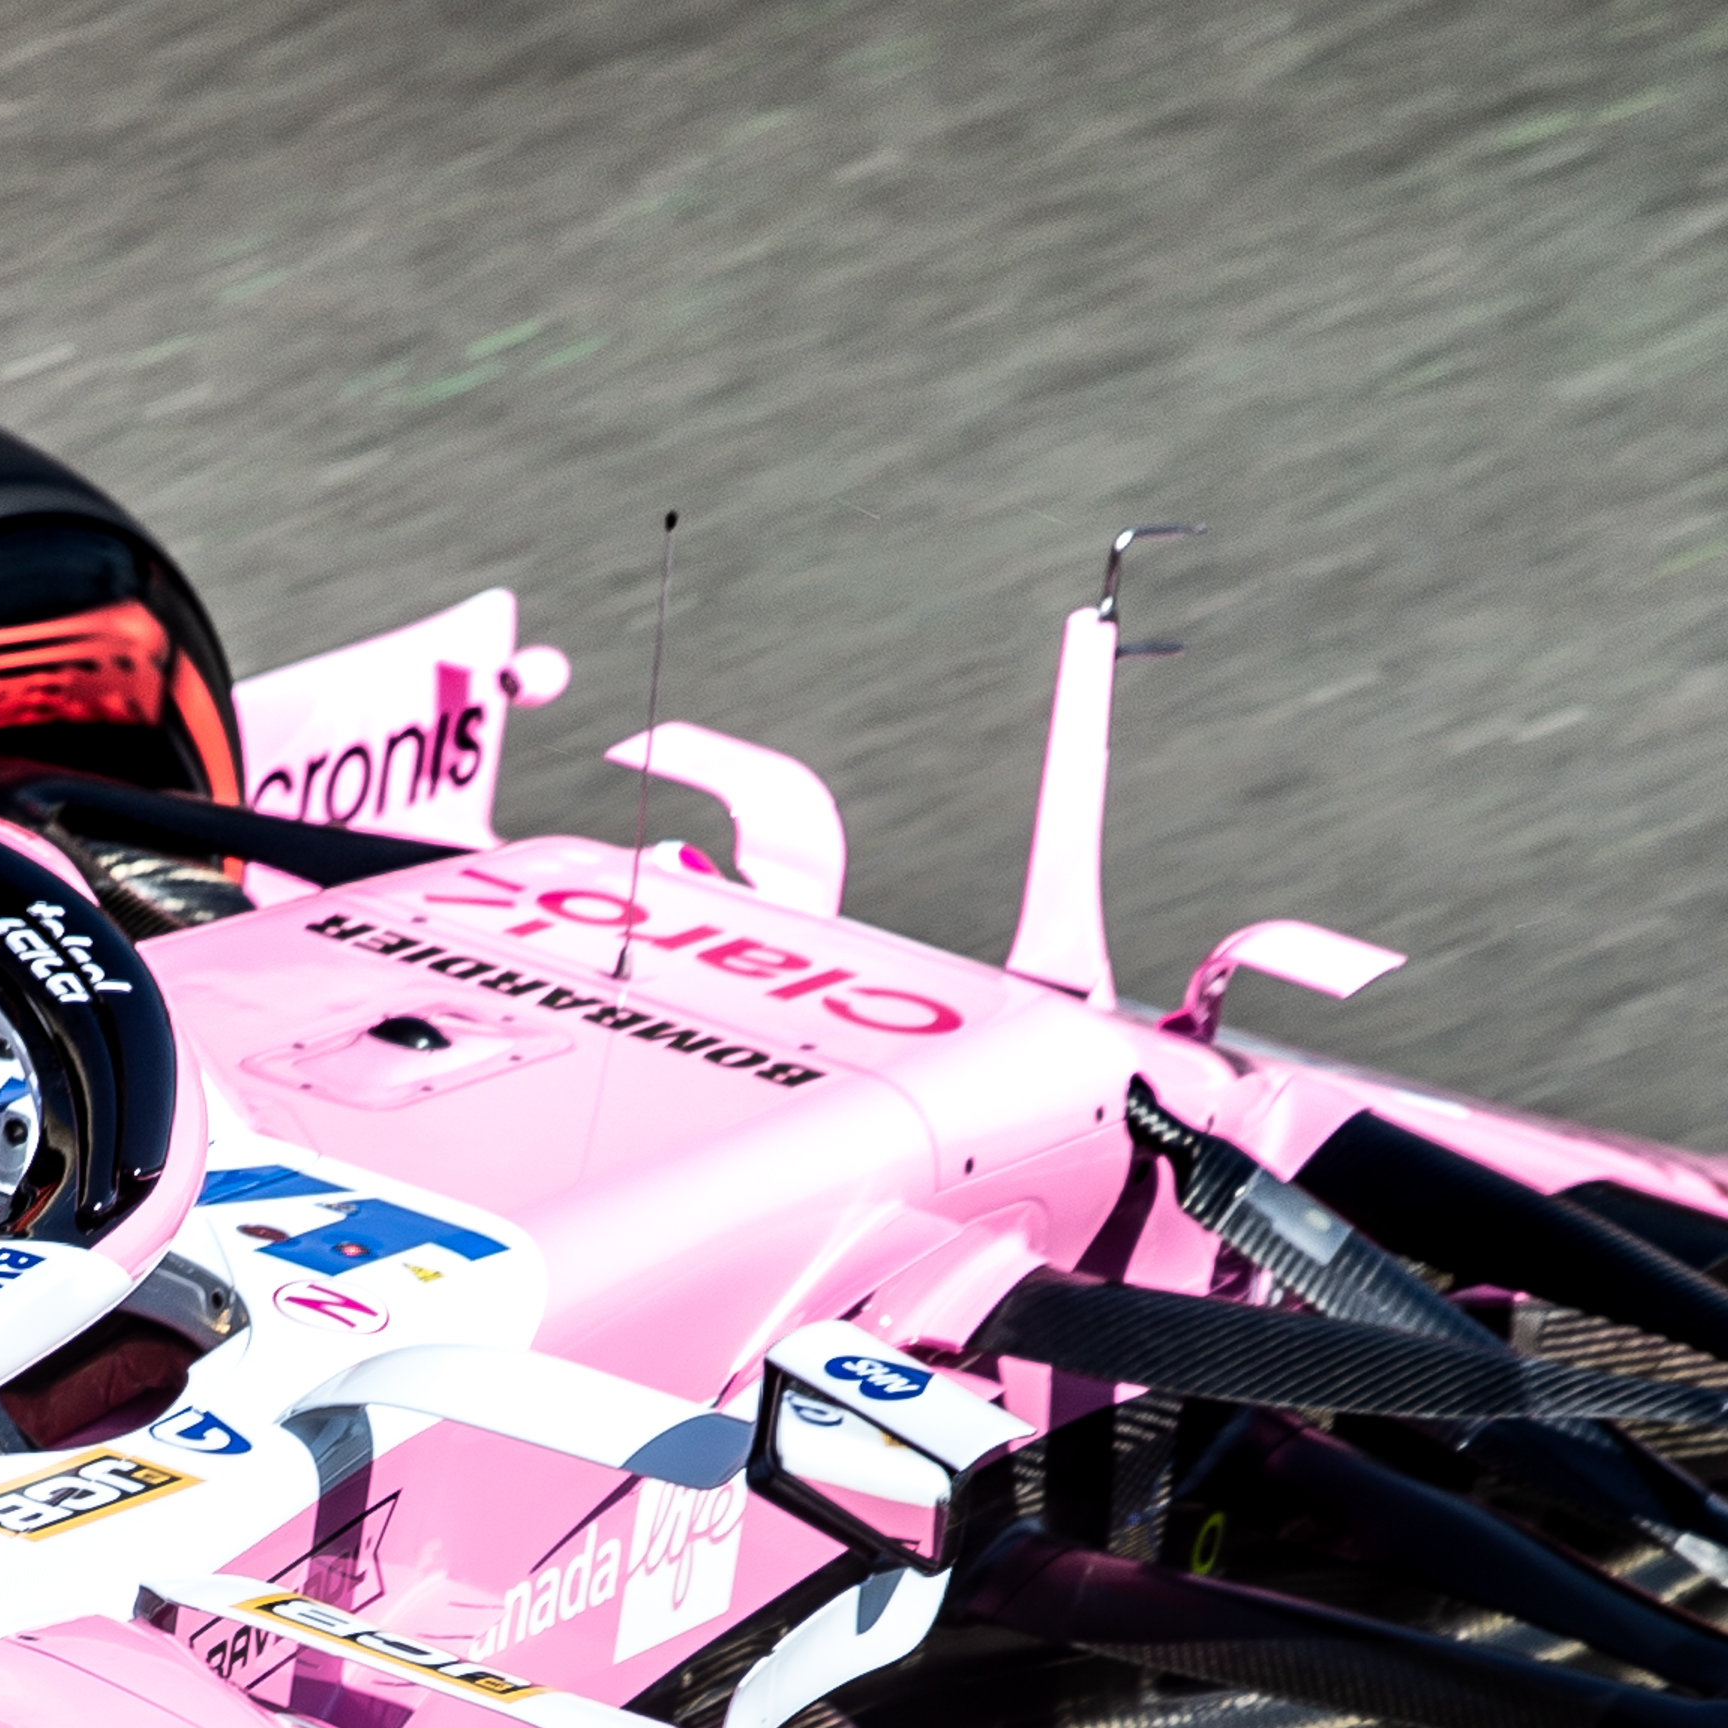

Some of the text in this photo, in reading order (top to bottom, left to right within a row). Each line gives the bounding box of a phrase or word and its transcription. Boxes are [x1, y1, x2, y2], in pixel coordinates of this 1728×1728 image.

[253, 707, 483, 823] cronis
[306, 913, 827, 1088] BOMBARDIER
[535, 889, 964, 1036] Claro
[271, 1598, 531, 1690] JCB
[468, 1520, 621, 1662] anada
